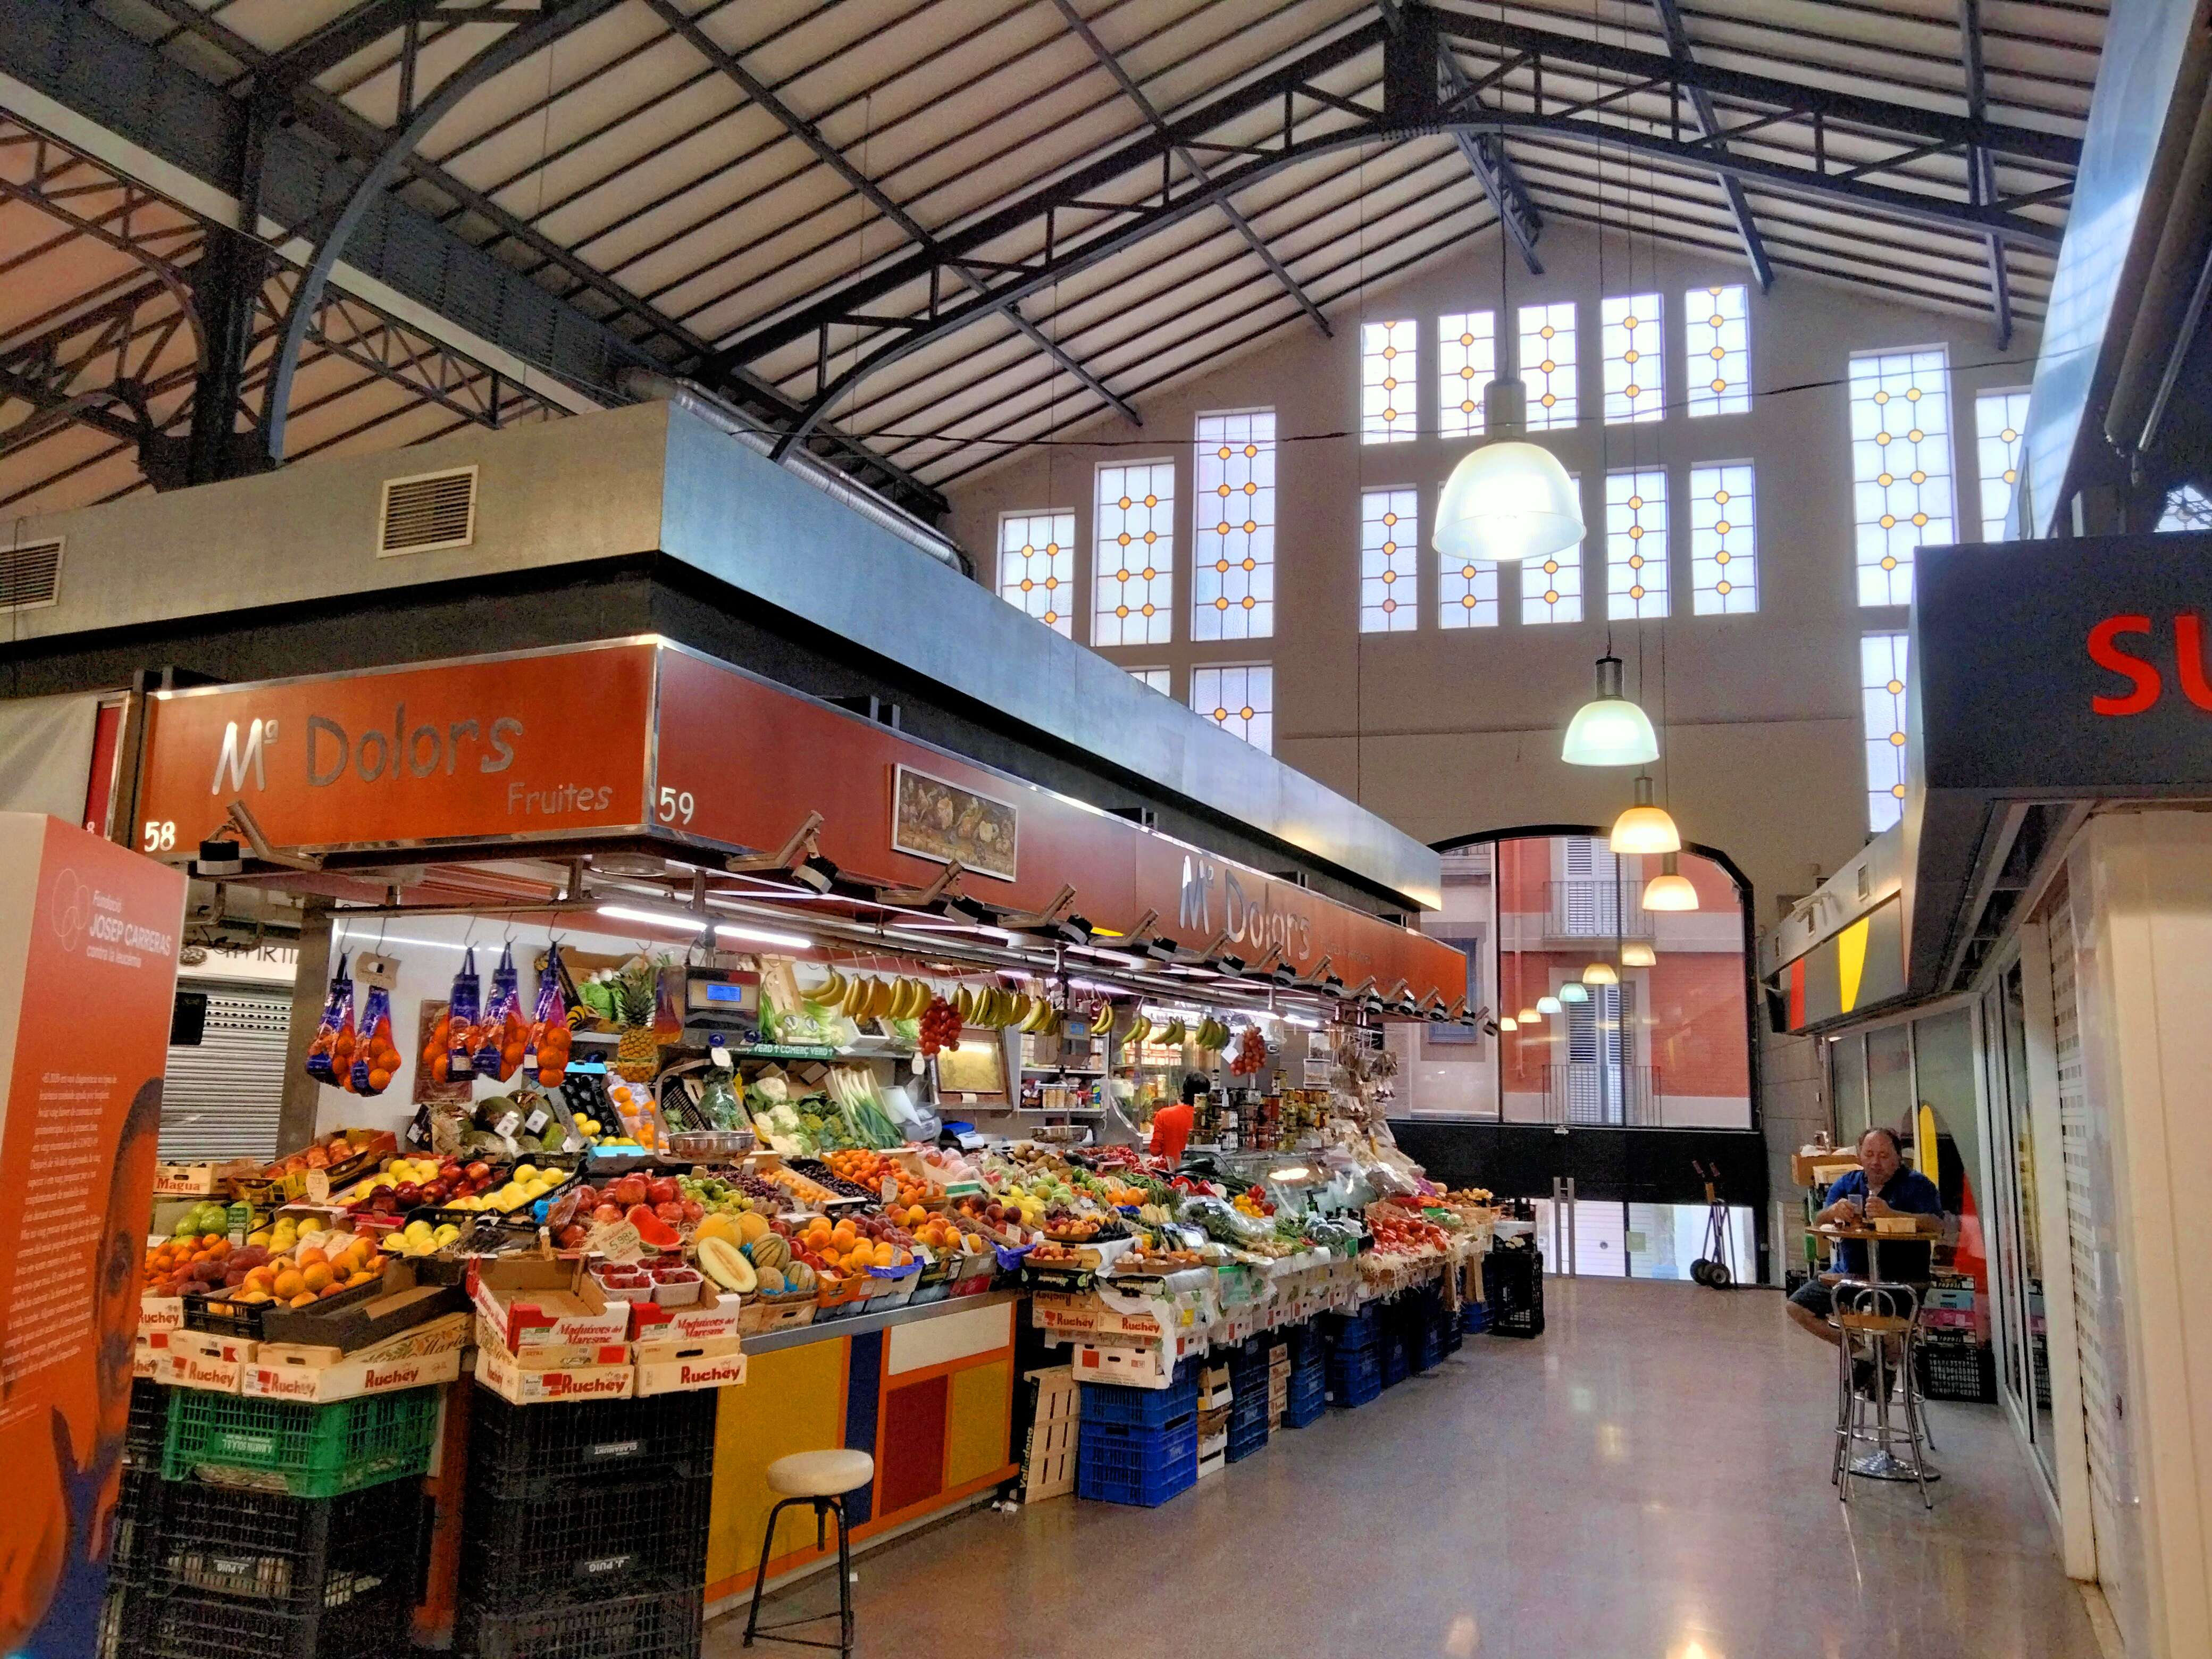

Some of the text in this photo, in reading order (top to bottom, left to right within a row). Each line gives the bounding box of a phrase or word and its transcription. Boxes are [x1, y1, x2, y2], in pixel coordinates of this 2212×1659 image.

[307, 702, 524, 786] Dolors
[507, 782, 614, 816] Fruites
[659, 786, 695, 825] 59
[144, 822, 175, 852] 58
[1225, 868, 1310, 960] Dolors
[89, 914, 124, 943] JOSEP
[754, 1043, 772, 1053] VERD
[780, 1045, 809, 1057] COMERÇ
[156, 1177, 200, 1192] Magua
[1057, 1313, 1094, 1328] Ruchey
[1122, 1317, 1160, 1333] Ruchey
[188, 1361, 237, 1388] Ruchey
[365, 1366, 420, 1388] Ruchey
[561, 1374, 626, 1394] Ruchey
[681, 1365, 741, 1384] Ruchey
[589, 1561, 613, 1572] PUIG
